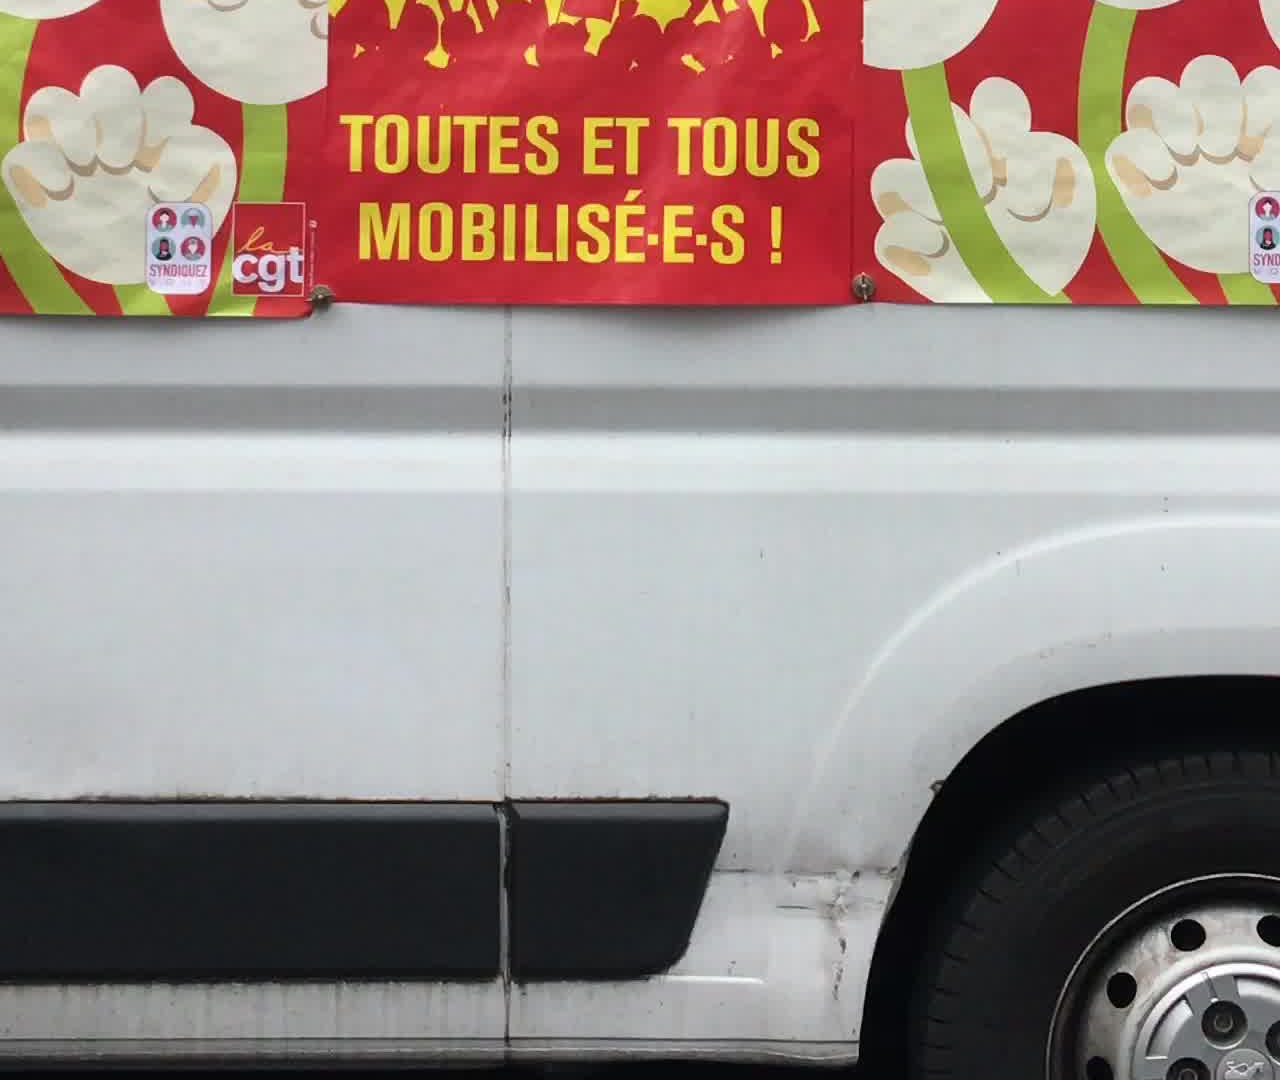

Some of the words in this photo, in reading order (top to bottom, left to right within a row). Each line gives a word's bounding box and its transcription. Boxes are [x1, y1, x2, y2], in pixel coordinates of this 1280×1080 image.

[339, 114, 559, 175] TOUTES
[582, 116, 649, 174] ET
[667, 117, 821, 178] TOUS
[770, 206, 783, 265] !
[150, 264, 208, 277] SYNDIQUEZ
[233, 246, 305, 292] cgt
